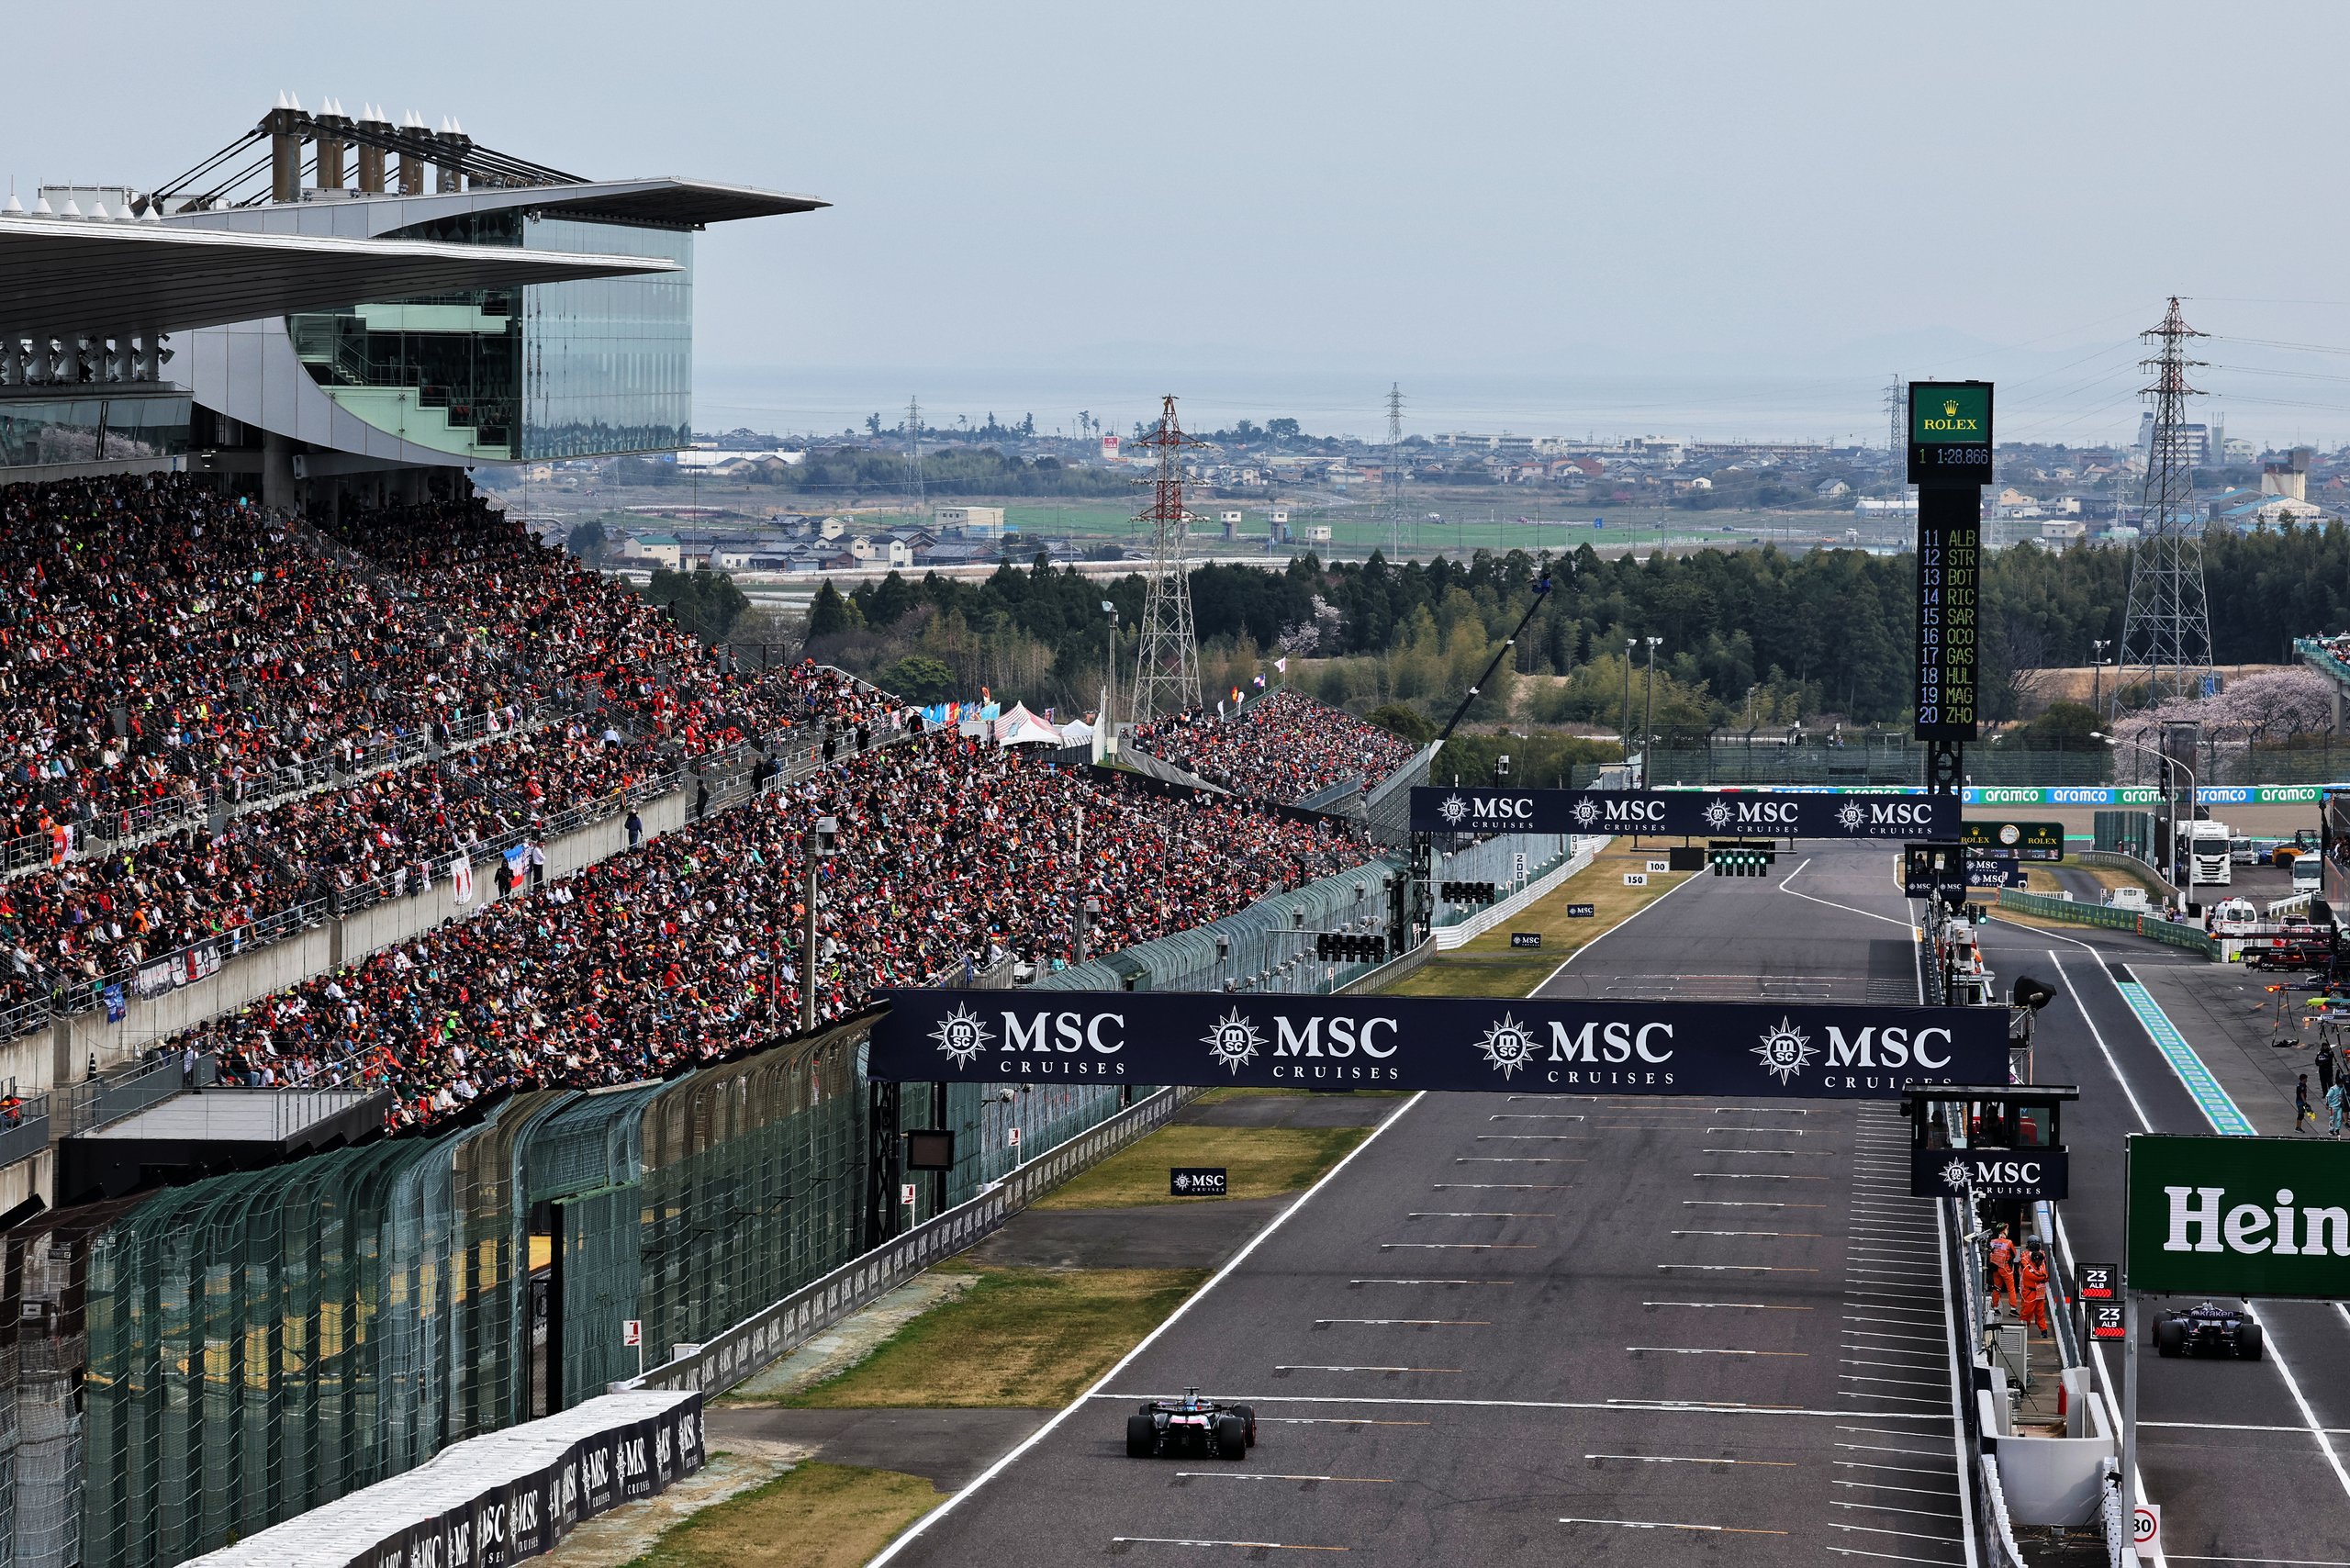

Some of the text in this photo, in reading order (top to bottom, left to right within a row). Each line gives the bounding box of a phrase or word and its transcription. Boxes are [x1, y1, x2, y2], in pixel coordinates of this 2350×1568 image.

[1924, 420, 1977, 430] ROLEX
[1919, 449, 1987, 464] 1 1:28.866
[1925, 530, 1975, 546] 11 ALB
[1924, 549, 1975, 566] 12 STR
[1924, 568, 1974, 585] 13 BOT
[1923, 588, 1974, 605] 14 RIC
[1923, 608, 1974, 624] 15 SAR
[1923, 628, 1974, 644] 16 OCO
[1922, 647, 1973, 664] 17 GAS
[1922, 667, 1973, 684] 18 HUL
[1922, 687, 1972, 703] 19 MAG
[1920, 707, 1972, 723] 20 ZHO
[1986, 790, 2039, 801] aramco
[2054, 790, 2107, 802] aramco
[2261, 787, 2315, 801] aramco
[1473, 798, 1532, 818] MSC
[1605, 801, 1664, 821] MSC
[1738, 802, 1797, 822] MSC
[1871, 804, 1931, 823] MSC
[1651, 863, 1665, 871] 100
[1975, 860, 1998, 869] MSC
[1628, 876, 1642, 884] 150
[1001, 1012, 1124, 1053] MSC
[1273, 1016, 1397, 1058] MSC
[1548, 1022, 1673, 1063] MSC
[1825, 1026, 1951, 1068] MSC
[1001, 1061, 1124, 1074] CRUISES
[1273, 1067, 1397, 1079] CRUISES
[1548, 1071, 1673, 1084] CRUISES
[1192, 1175, 1224, 1186] MSC
[1976, 1162, 2040, 1183] MSC
[2164, 1186, 2350, 1256] Hein
[2087, 1271, 2107, 1282] 23
[2098, 1308, 2120, 1320] 23
[589, 1447, 610, 1489] MSC
[518, 1489, 538, 1533] MSC
